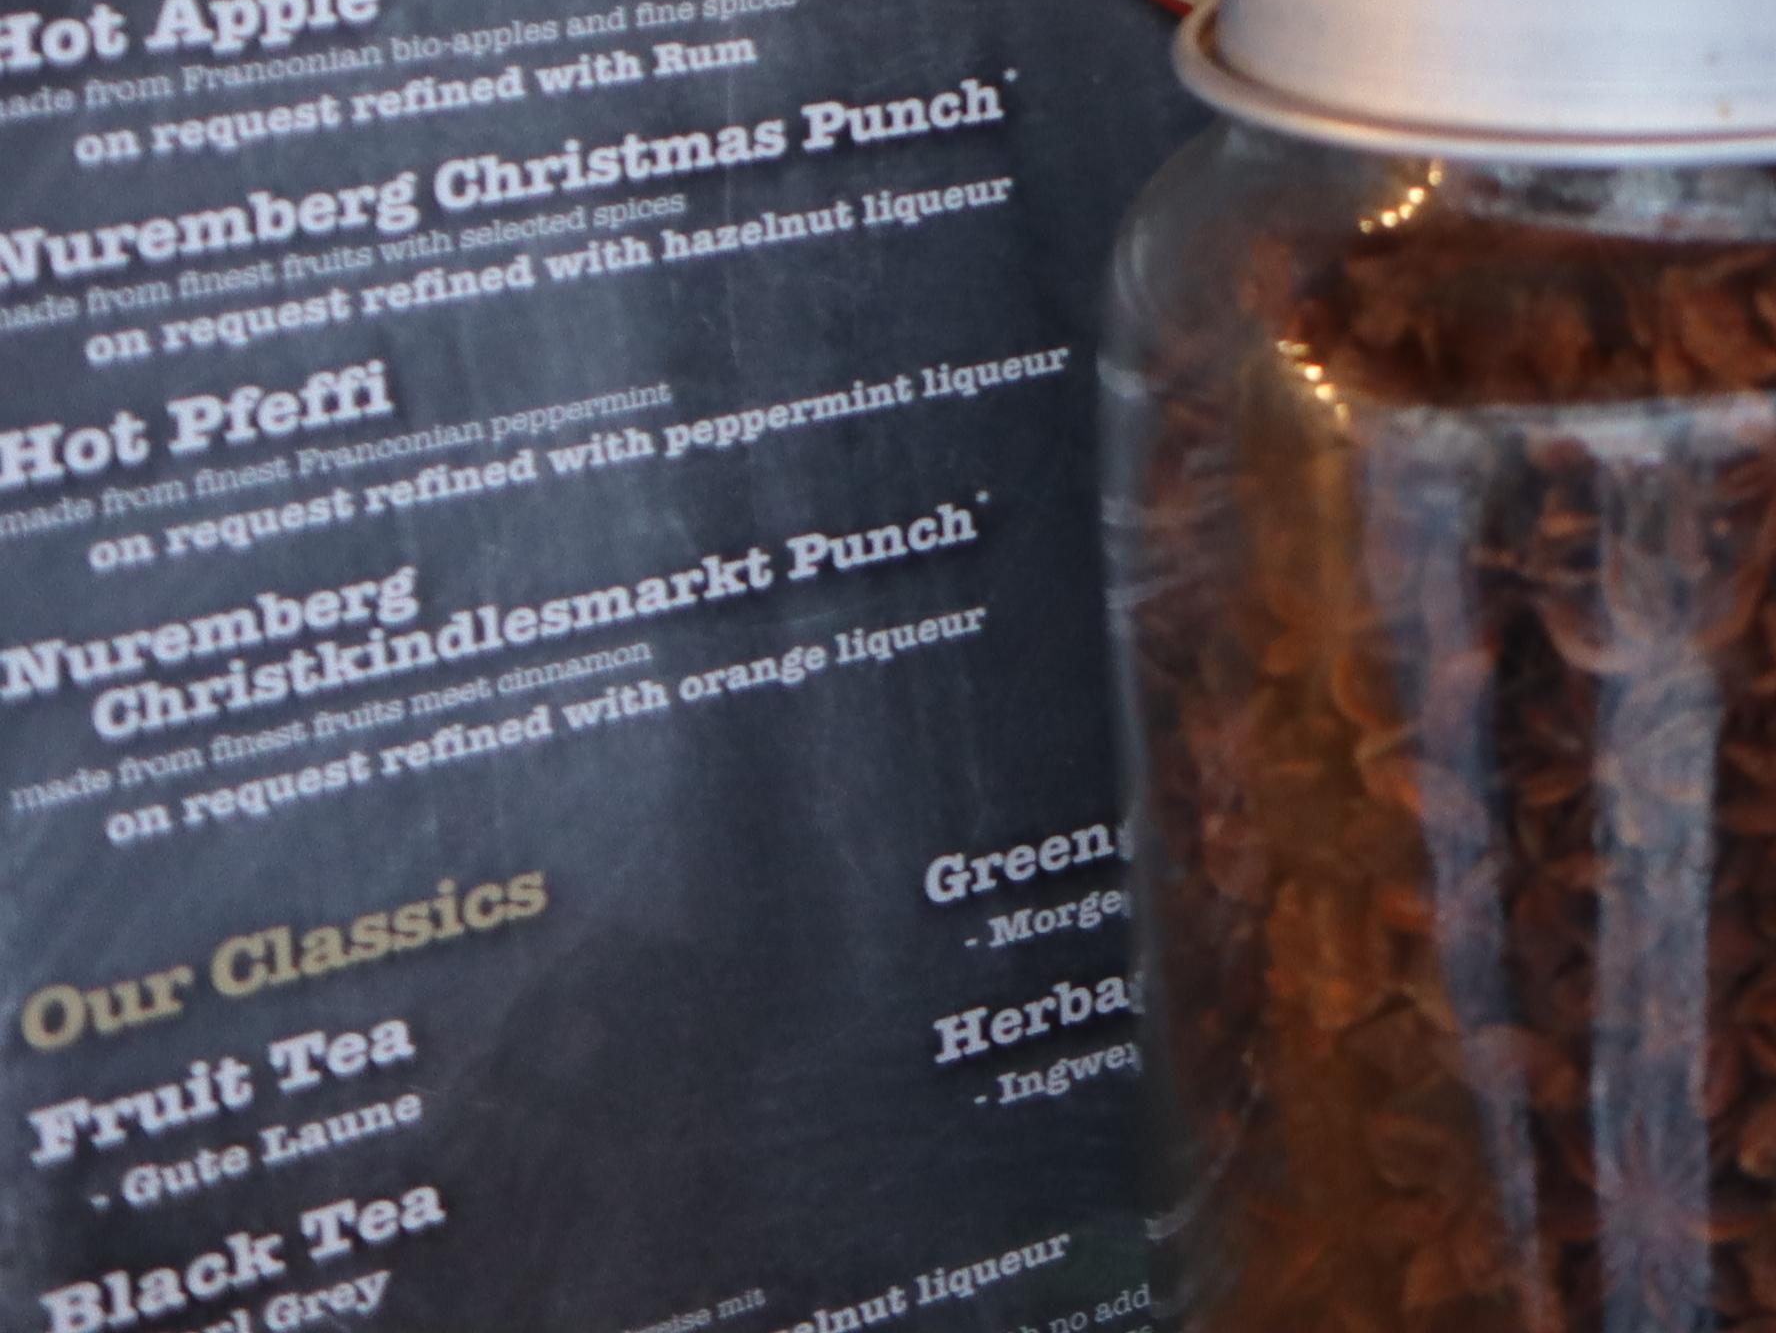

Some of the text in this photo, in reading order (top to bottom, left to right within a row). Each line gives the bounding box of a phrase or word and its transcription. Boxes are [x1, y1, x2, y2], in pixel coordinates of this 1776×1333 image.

[84, 75, 174, 112] from
[182, 45, 384, 96] Franconian
[390, 20, 559, 64] bio-apples
[567, 6, 627, 38] and
[636, 1, 696, 28] fine
[435, 119, 786, 210] Christmas
[86, 177, 1012, 365] on request refined with hazelnut liqueur
[0, 359, 392, 488] Hot Pfeffi
[90, 347, 1068, 571] on request refined with peppermint liqueur
[0, 566, 418, 699] Nuremberg
[93, 547, 772, 739] Christkindlesmarkt
[925, 823, 1115, 904] Green
[22, 870, 546, 1048] Our Classics
[934, 974, 1128, 1065] Herba
[29, 1020, 414, 1165] Fruit Tea
[123, 1094, 421, 1205] Gute Laune
[41, 1232, 286, 1333] Black
[302, 1186, 444, 1260] Tea
[264, 1269, 391, 1331] Grey
